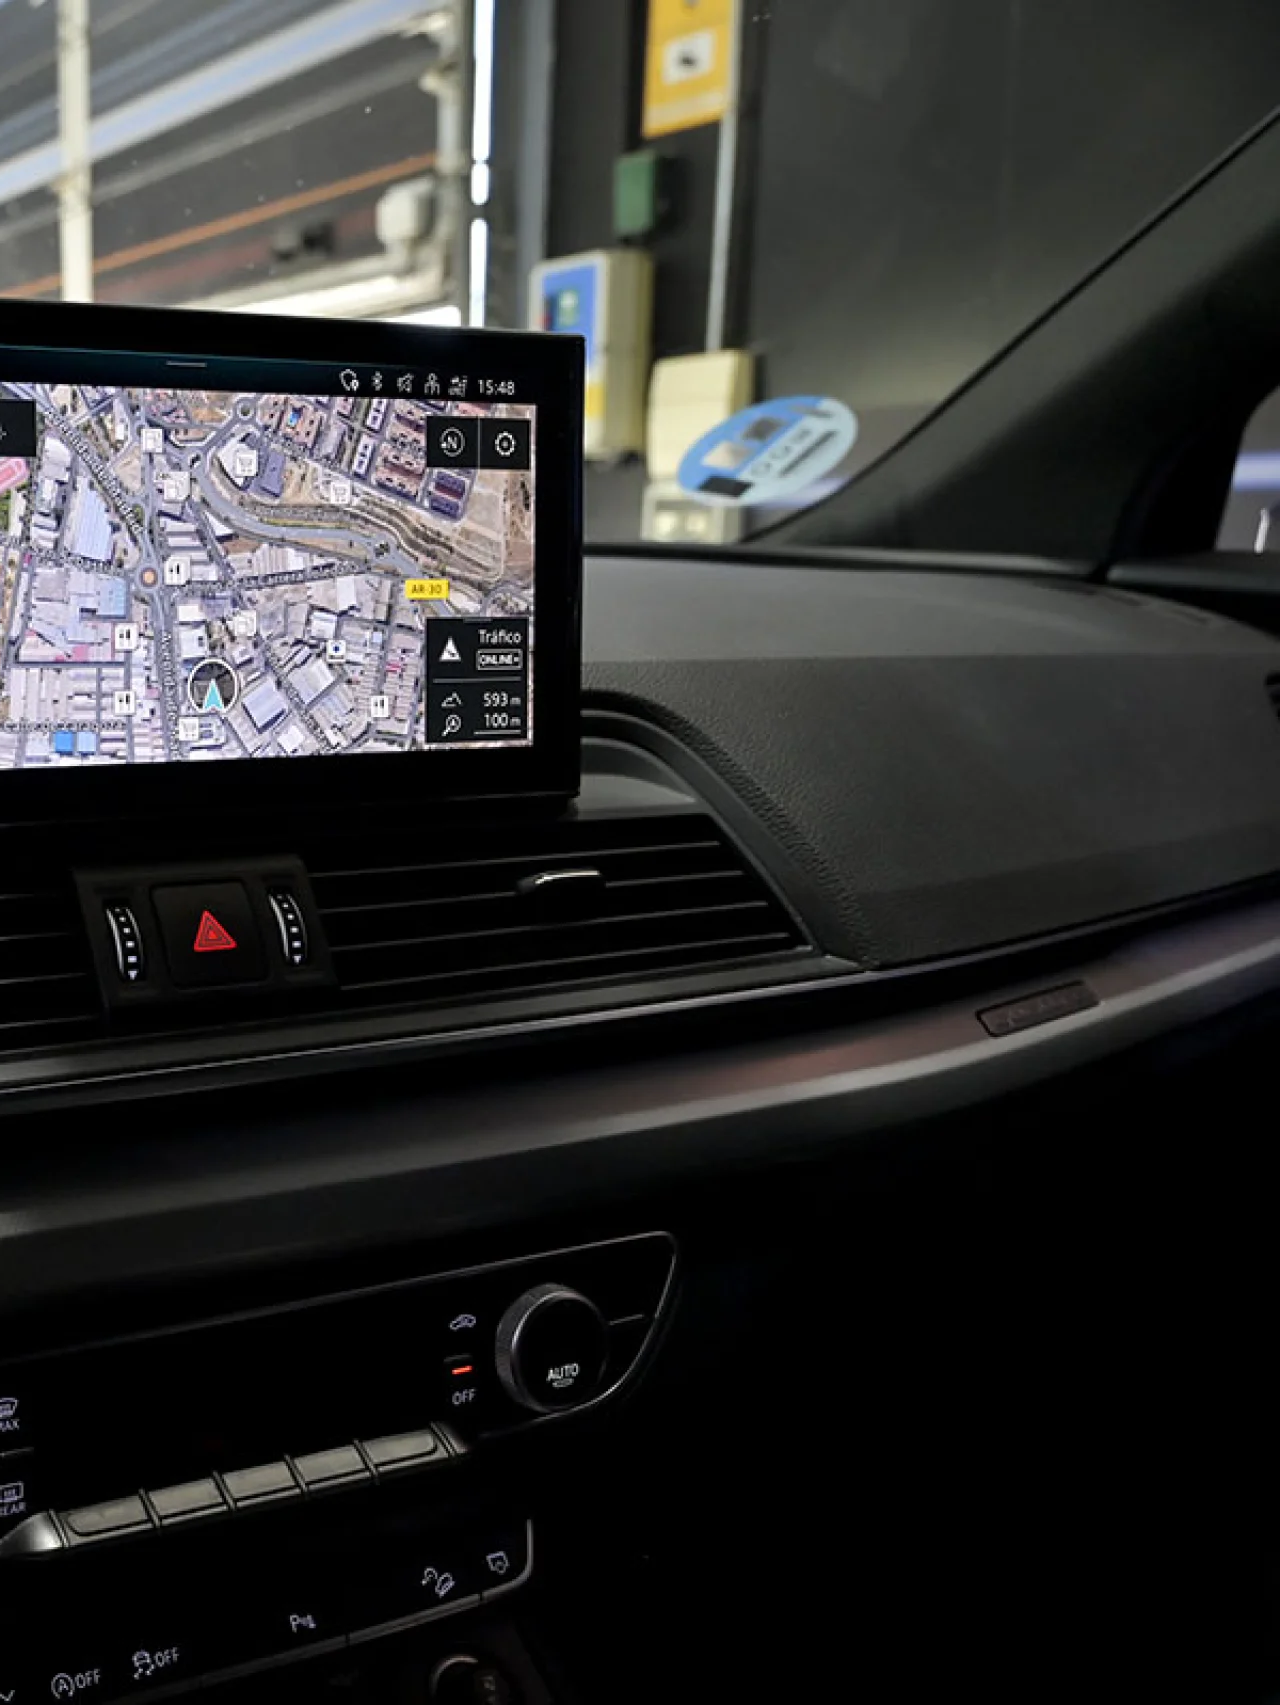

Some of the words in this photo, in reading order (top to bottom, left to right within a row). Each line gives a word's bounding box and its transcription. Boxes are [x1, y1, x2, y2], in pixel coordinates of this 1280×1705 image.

[478, 379, 516, 396] 15:48
[478, 628, 522, 644] Tráfico
[483, 691, 509, 707] 593
[509, 697, 522, 706] m
[484, 712, 509, 728] 100
[509, 716, 522, 727] m
[547, 1363, 580, 1383] AUTO
[451, 1387, 477, 1406] OFF
[154, 1647, 180, 1668] OFF
[75, 1668, 101, 1689] OFF
